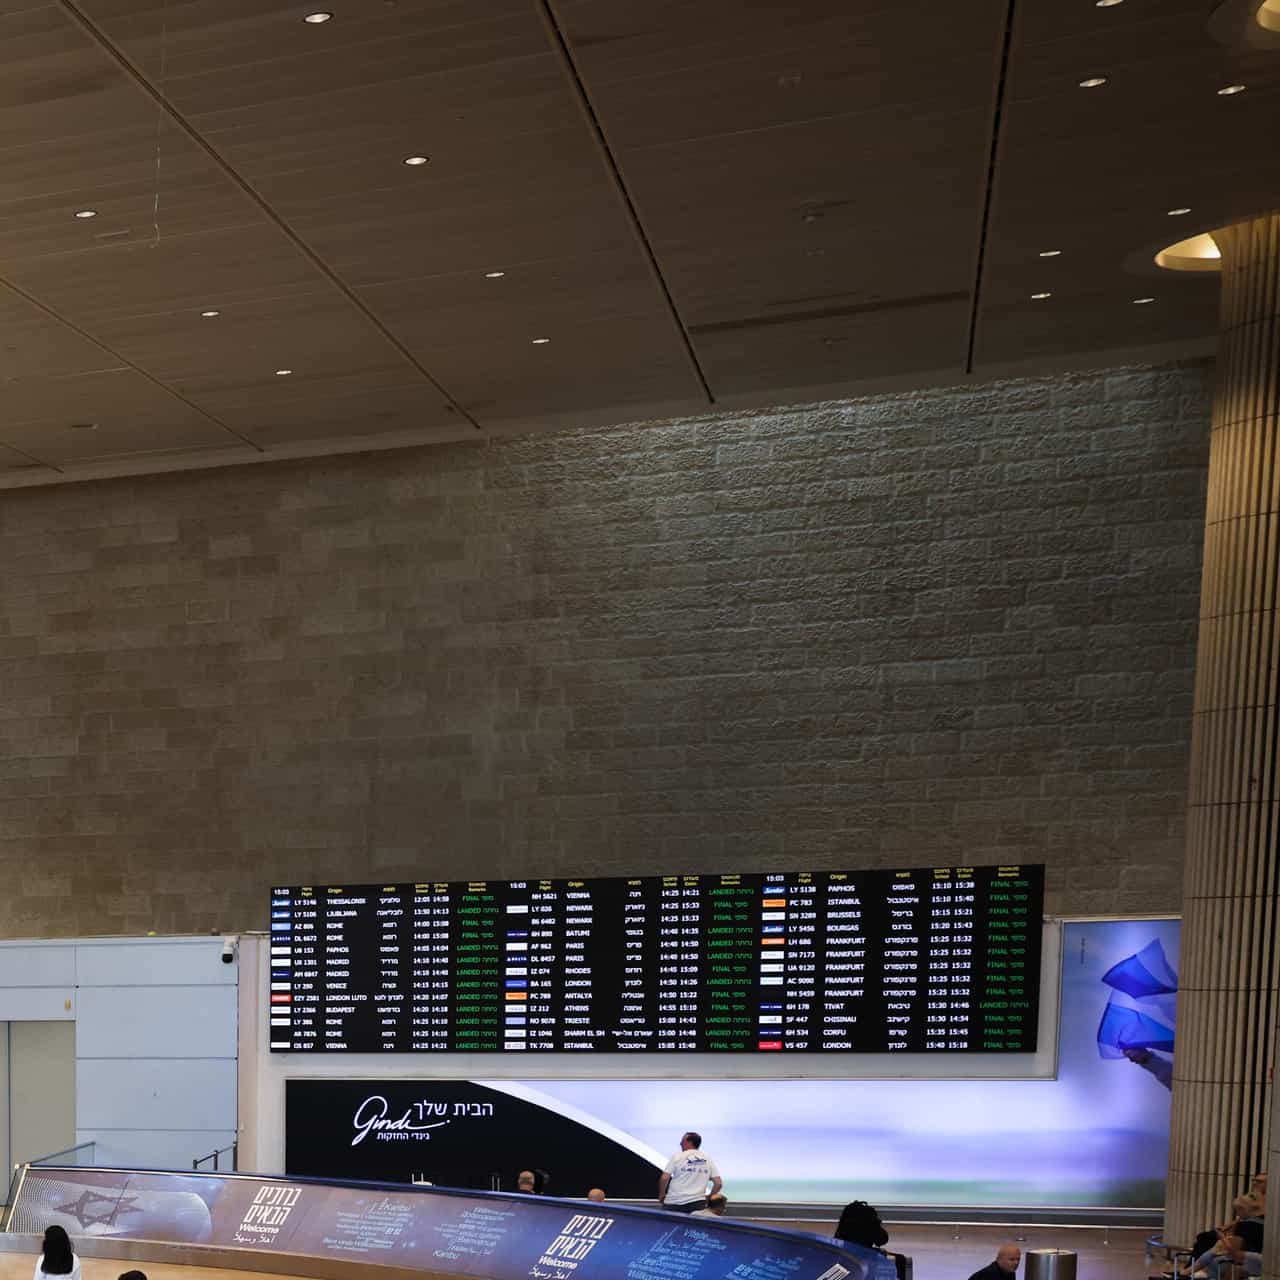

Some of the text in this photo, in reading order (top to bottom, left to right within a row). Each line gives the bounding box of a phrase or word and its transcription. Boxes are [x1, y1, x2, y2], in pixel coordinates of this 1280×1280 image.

[954, 908, 973, 916] 15:21
[826, 924, 859, 932] BOURGAS
[826, 950, 865, 958] FRANKFURT
[825, 963, 865, 971] FRANKFURT
[413, 1100, 494, 1120] הבית שלך
[376, 1132, 430, 1142] גינדי החזקות
[253, 1185, 303, 1207] ברוכים
[243, 1205, 292, 1226] הבאים
[239, 1223, 280, 1235] Welcome
[561, 1214, 614, 1239] ברוכים
[545, 1235, 597, 1260] הבאים
[538, 1255, 578, 1269] Welcome
